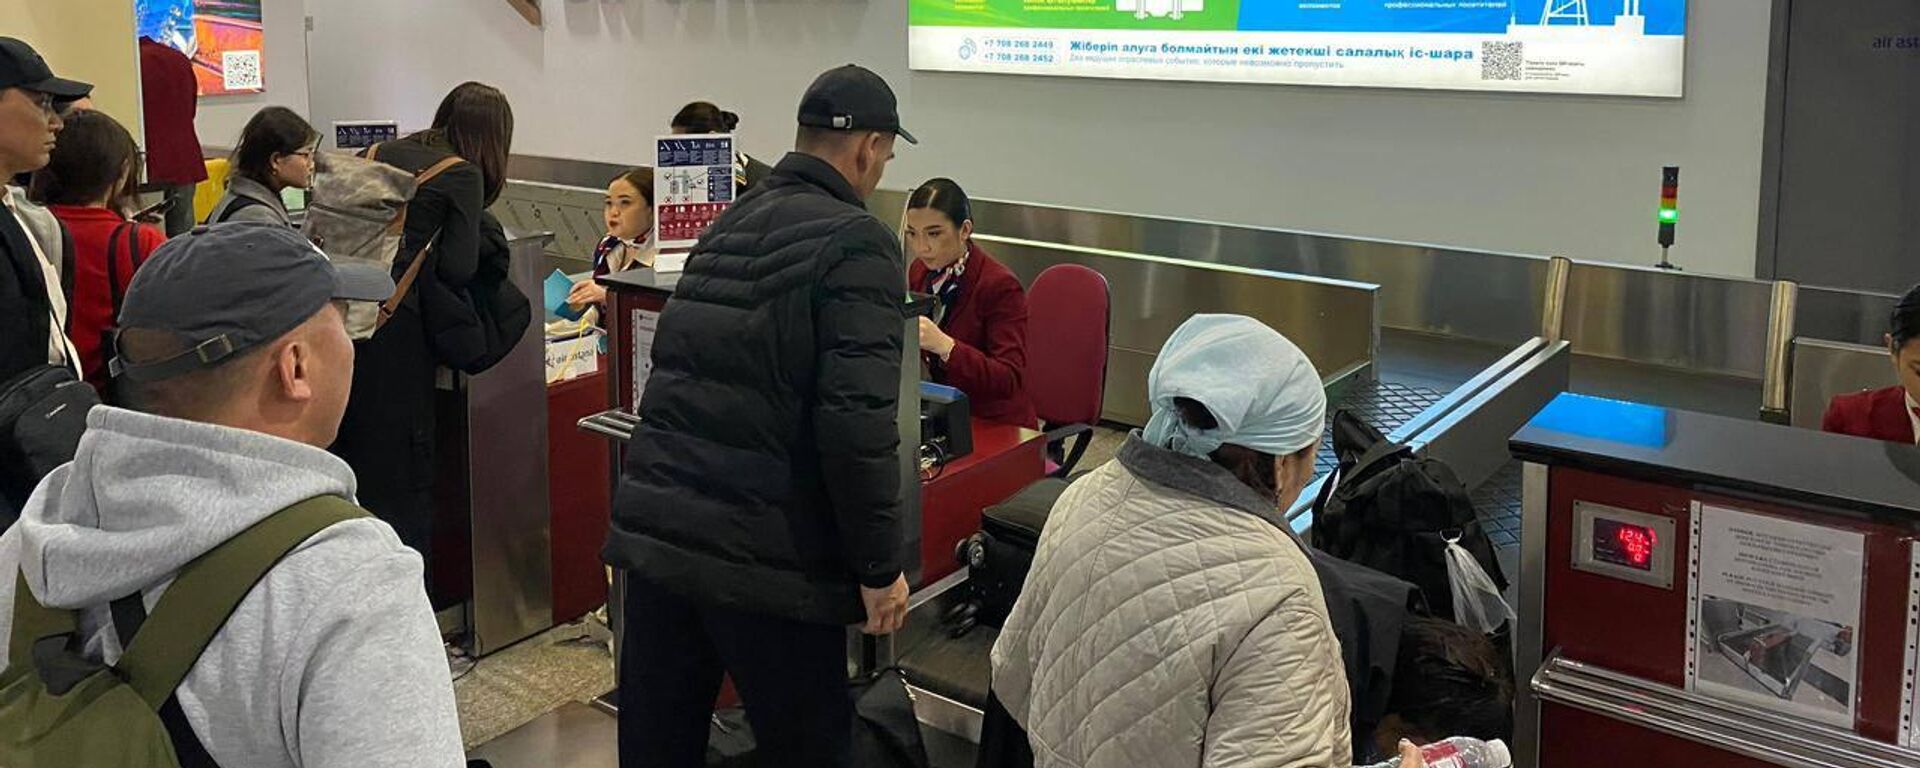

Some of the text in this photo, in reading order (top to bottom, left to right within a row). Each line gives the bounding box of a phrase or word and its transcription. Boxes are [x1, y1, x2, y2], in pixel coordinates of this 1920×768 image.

[1872, 37, 1892, 48] air
[1070, 41, 1118, 54] Жіберіп
[1161, 43, 1238, 55] болмайтын
[1243, 45, 1264, 55] екі
[1268, 46, 1331, 57] жетекші
[1336, 48, 1405, 59] салалық
[1409, 47, 1473, 61] іс-шара
